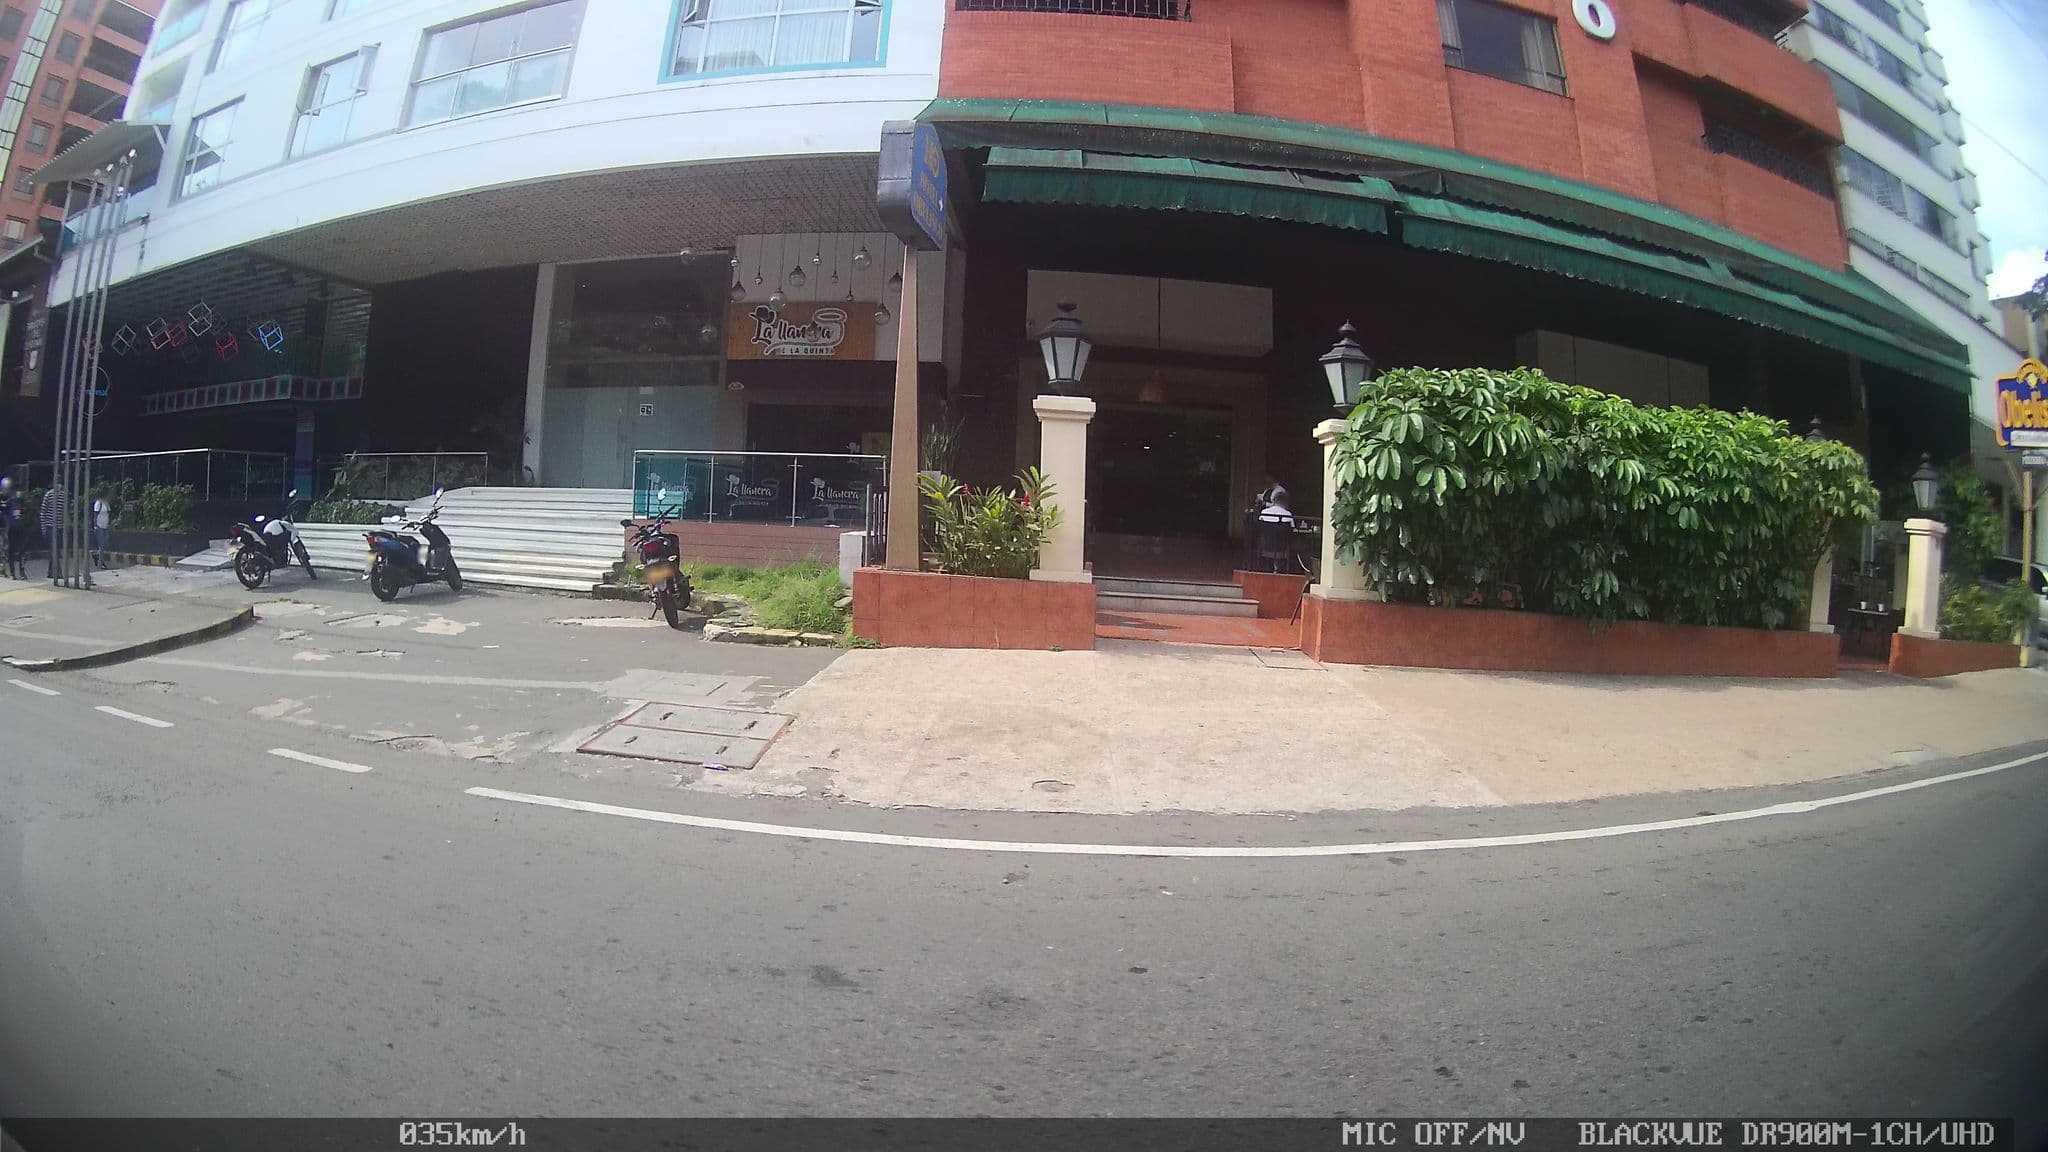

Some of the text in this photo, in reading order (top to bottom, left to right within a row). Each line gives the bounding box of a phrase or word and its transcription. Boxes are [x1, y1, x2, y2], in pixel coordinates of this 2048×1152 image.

[751, 311, 775, 345] La
[726, 478, 772, 498] La llanera
[811, 481, 859, 502] La llanera
